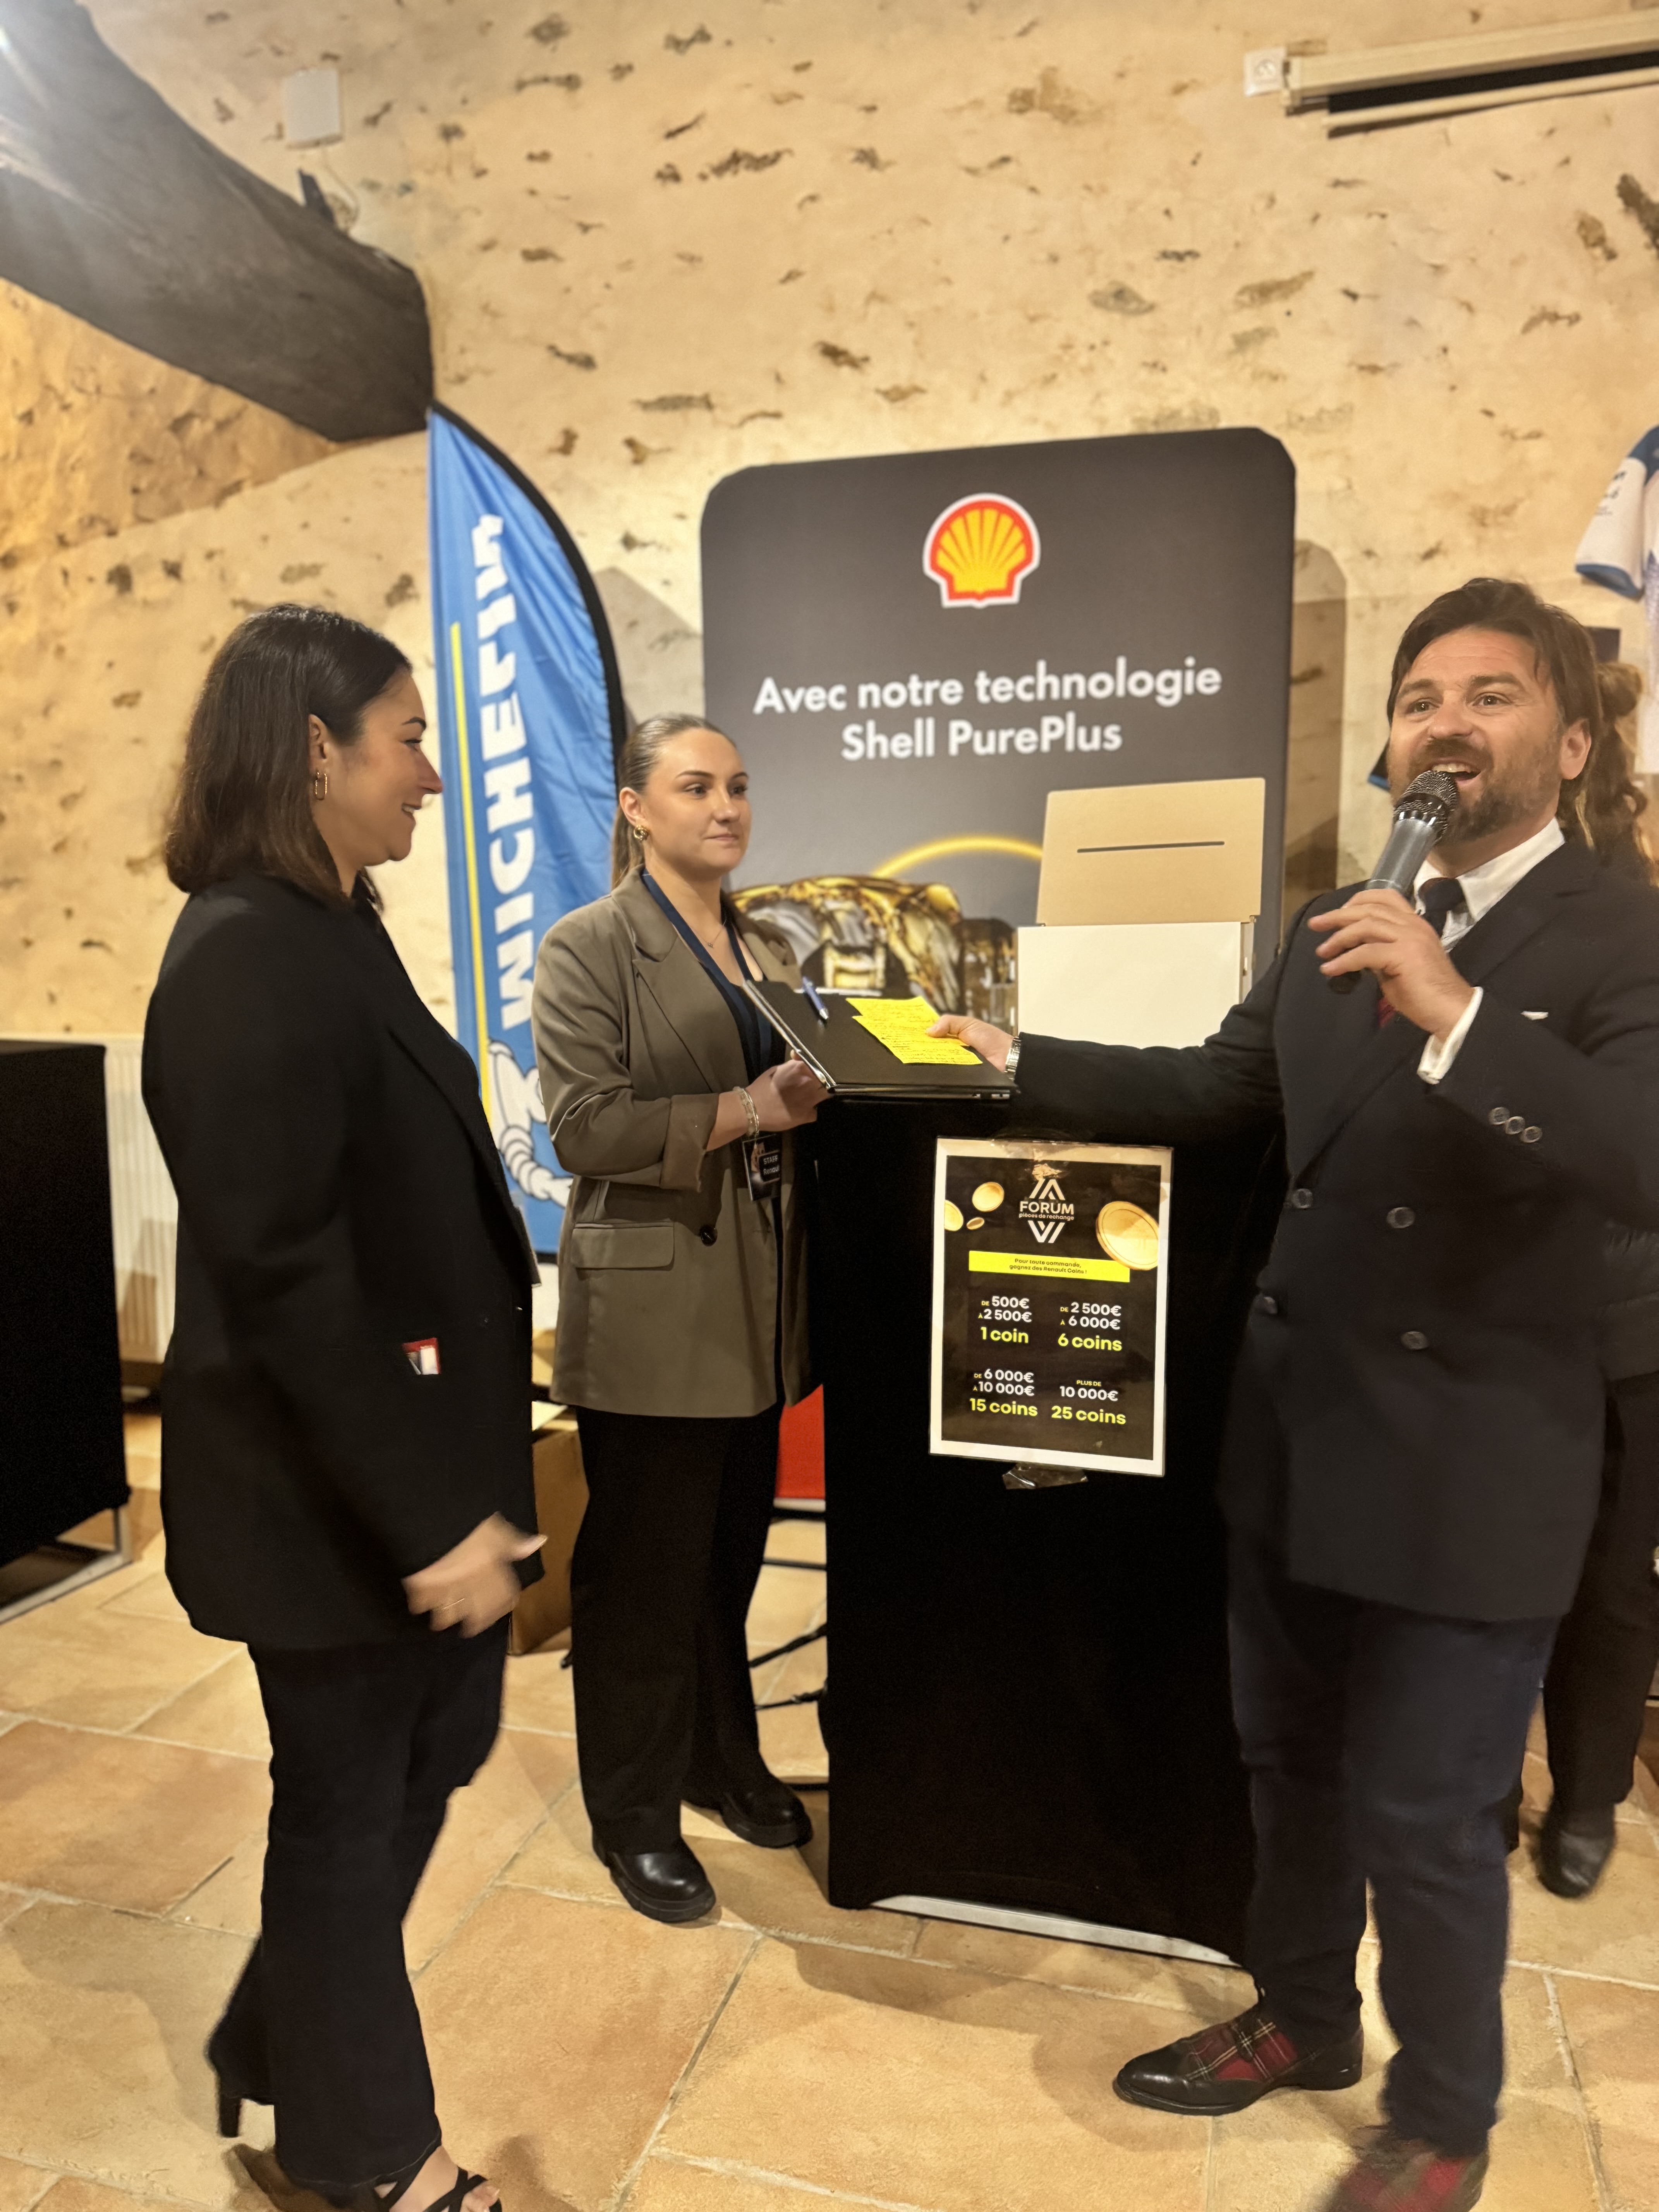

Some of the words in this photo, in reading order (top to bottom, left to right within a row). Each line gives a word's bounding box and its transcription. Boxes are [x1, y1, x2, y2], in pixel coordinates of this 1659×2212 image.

[753, 677, 847, 714] Avec
[858, 674, 963, 709] notre
[975, 656, 1222, 707] technologie
[842, 718, 934, 760] Shell
[948, 711, 1122, 756] PurePlus
[471, 514, 536, 1030] MICHELIN
[763, 1155, 778, 1164] STAFF
[764, 1165, 780, 1175] Renaul
[1020, 1201, 1074, 1215] FORUM
[992, 1296, 1030, 1309] 500€
[981, 1327, 987, 1340] 1
[990, 1328, 1029, 1343] coin
[1058, 1333, 1069, 1346] 6
[1072, 1335, 1122, 1351] coins
[970, 1398, 986, 1412] 15
[989, 1401, 1038, 1416] coins
[1051, 1405, 1072, 1419] 25
[1076, 1409, 1126, 1424] coins
